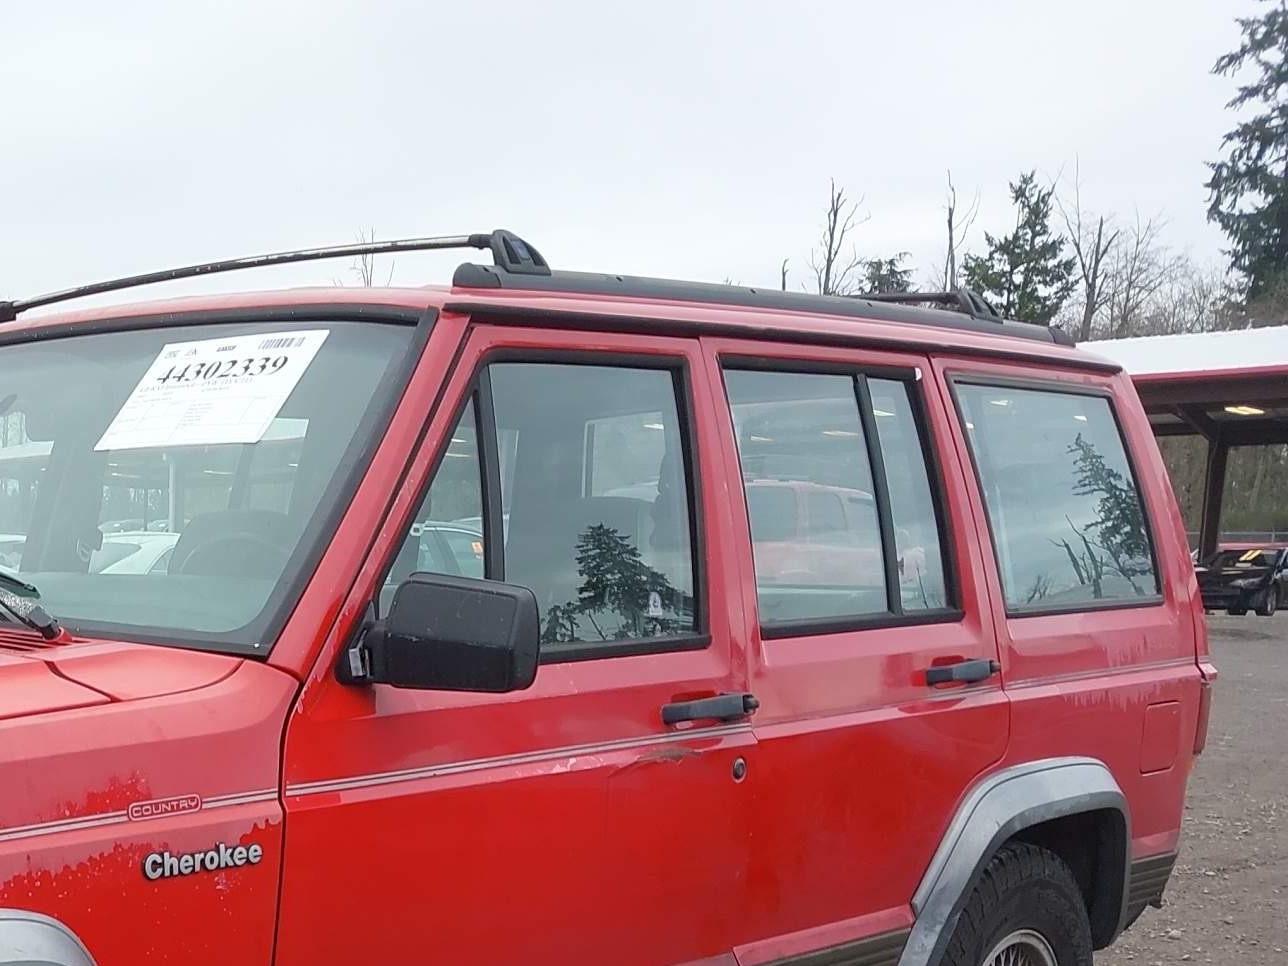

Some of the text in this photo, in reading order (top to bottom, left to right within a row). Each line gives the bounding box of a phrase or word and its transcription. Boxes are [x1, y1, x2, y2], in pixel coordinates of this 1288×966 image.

[156, 355, 289, 384] 44302339
[130, 798, 198, 818] COUNTRY
[143, 843, 263, 881] Cherokee
